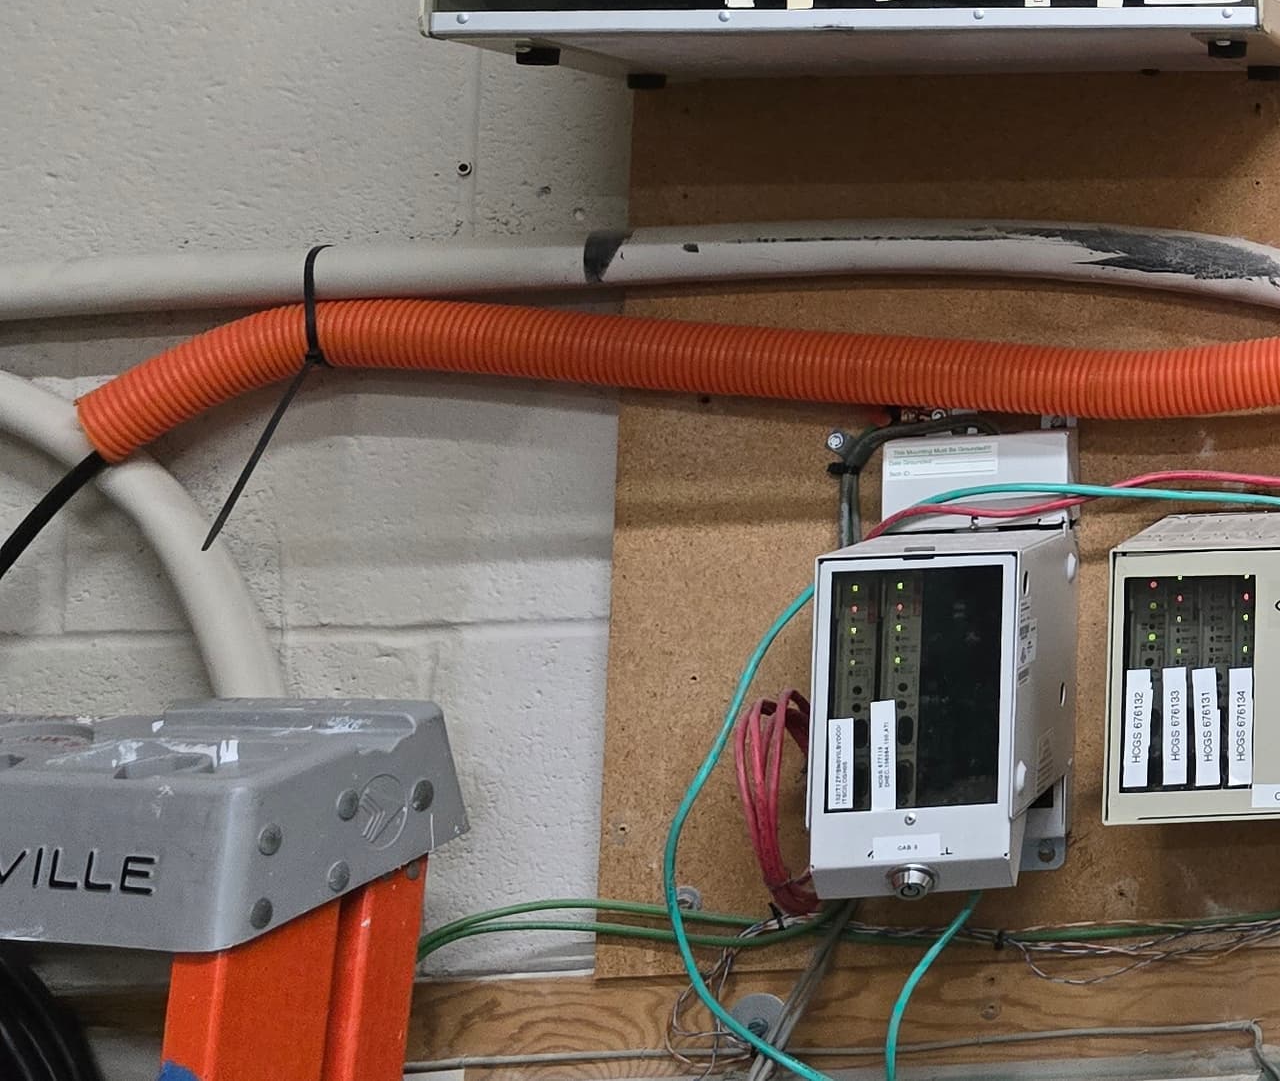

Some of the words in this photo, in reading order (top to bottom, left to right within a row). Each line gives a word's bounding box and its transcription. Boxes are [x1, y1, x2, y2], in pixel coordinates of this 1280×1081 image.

[1133, 691, 1144, 729] 676132
[1170, 690, 1180, 727] 676133
[1201, 691, 1212, 727] 676131
[1236, 690, 1246, 727] 676134
[1131, 732, 1142, 763] HCGS
[1170, 730, 1180, 761] HCGS
[1202, 730, 1213, 762] HCGS
[1236, 730, 1246, 762] HCGS
